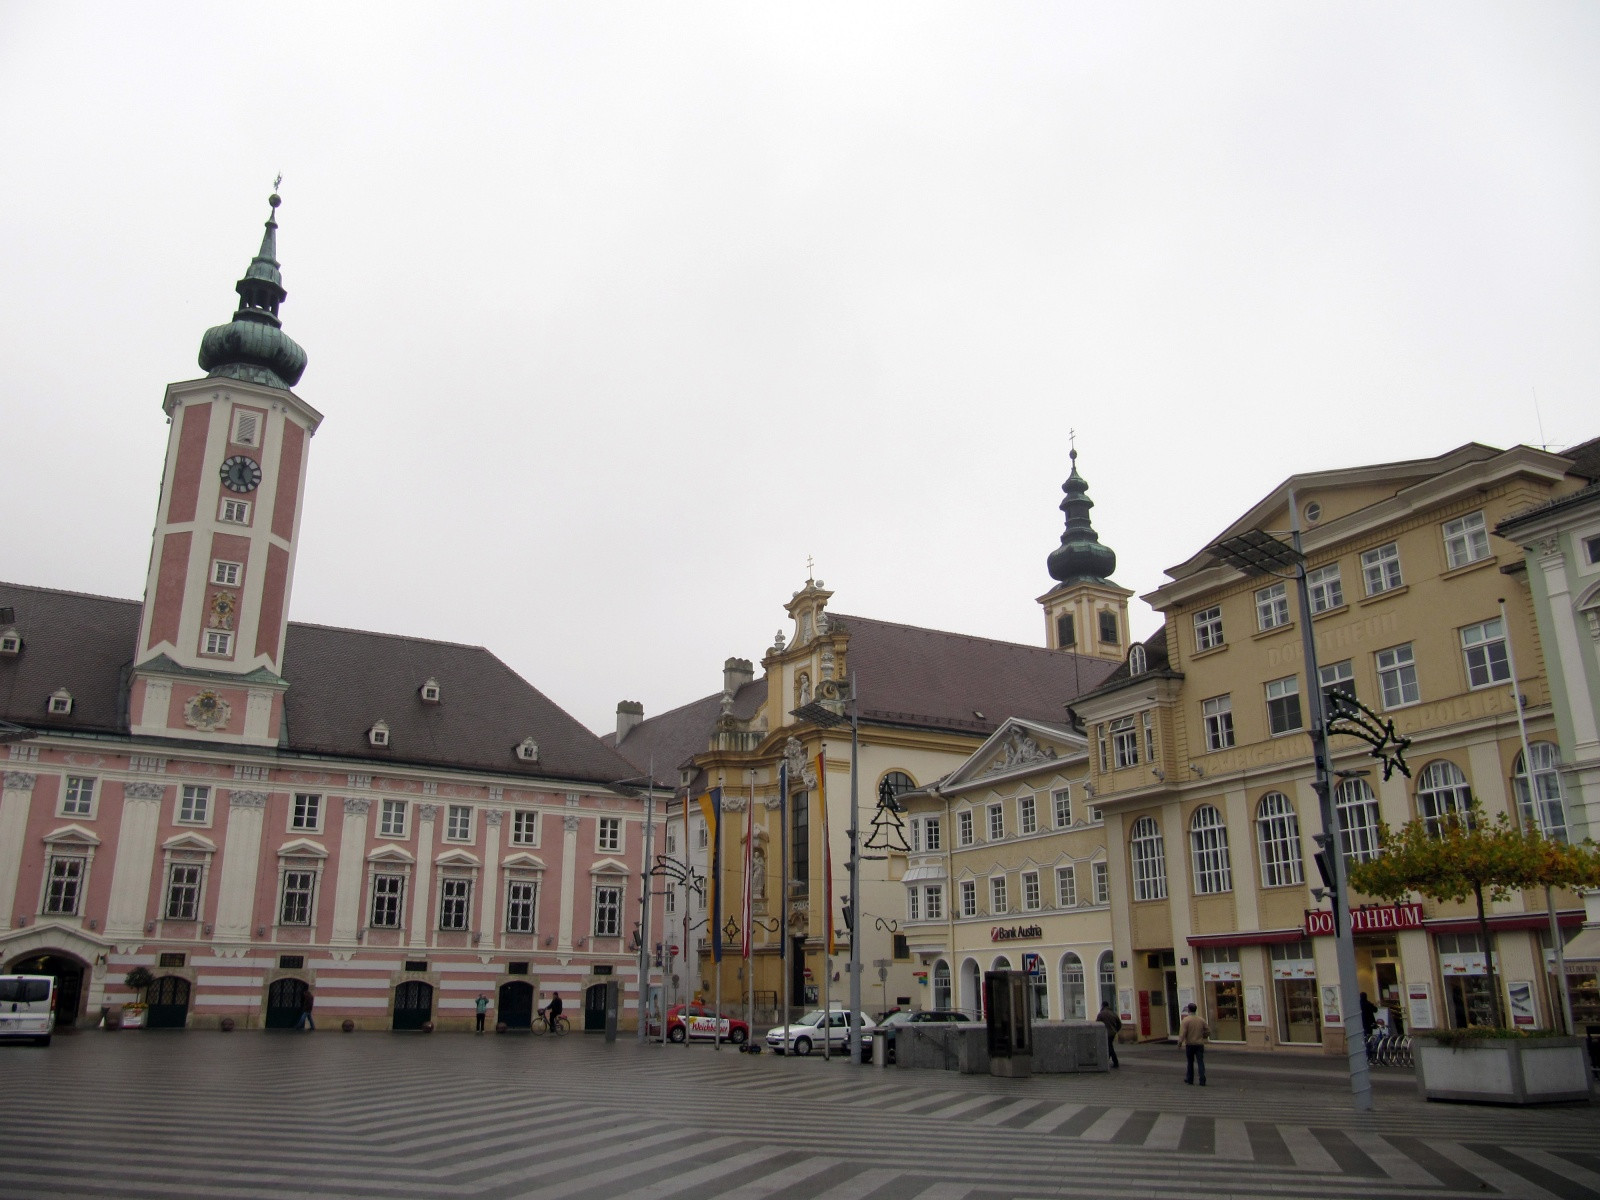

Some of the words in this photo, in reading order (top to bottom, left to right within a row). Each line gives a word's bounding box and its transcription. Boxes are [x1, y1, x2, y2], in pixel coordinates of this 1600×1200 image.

[1308, 906, 1420, 932] DOTHEUM
[998, 926, 1017, 939] Bank
[1018, 923, 1042, 938] Austria
